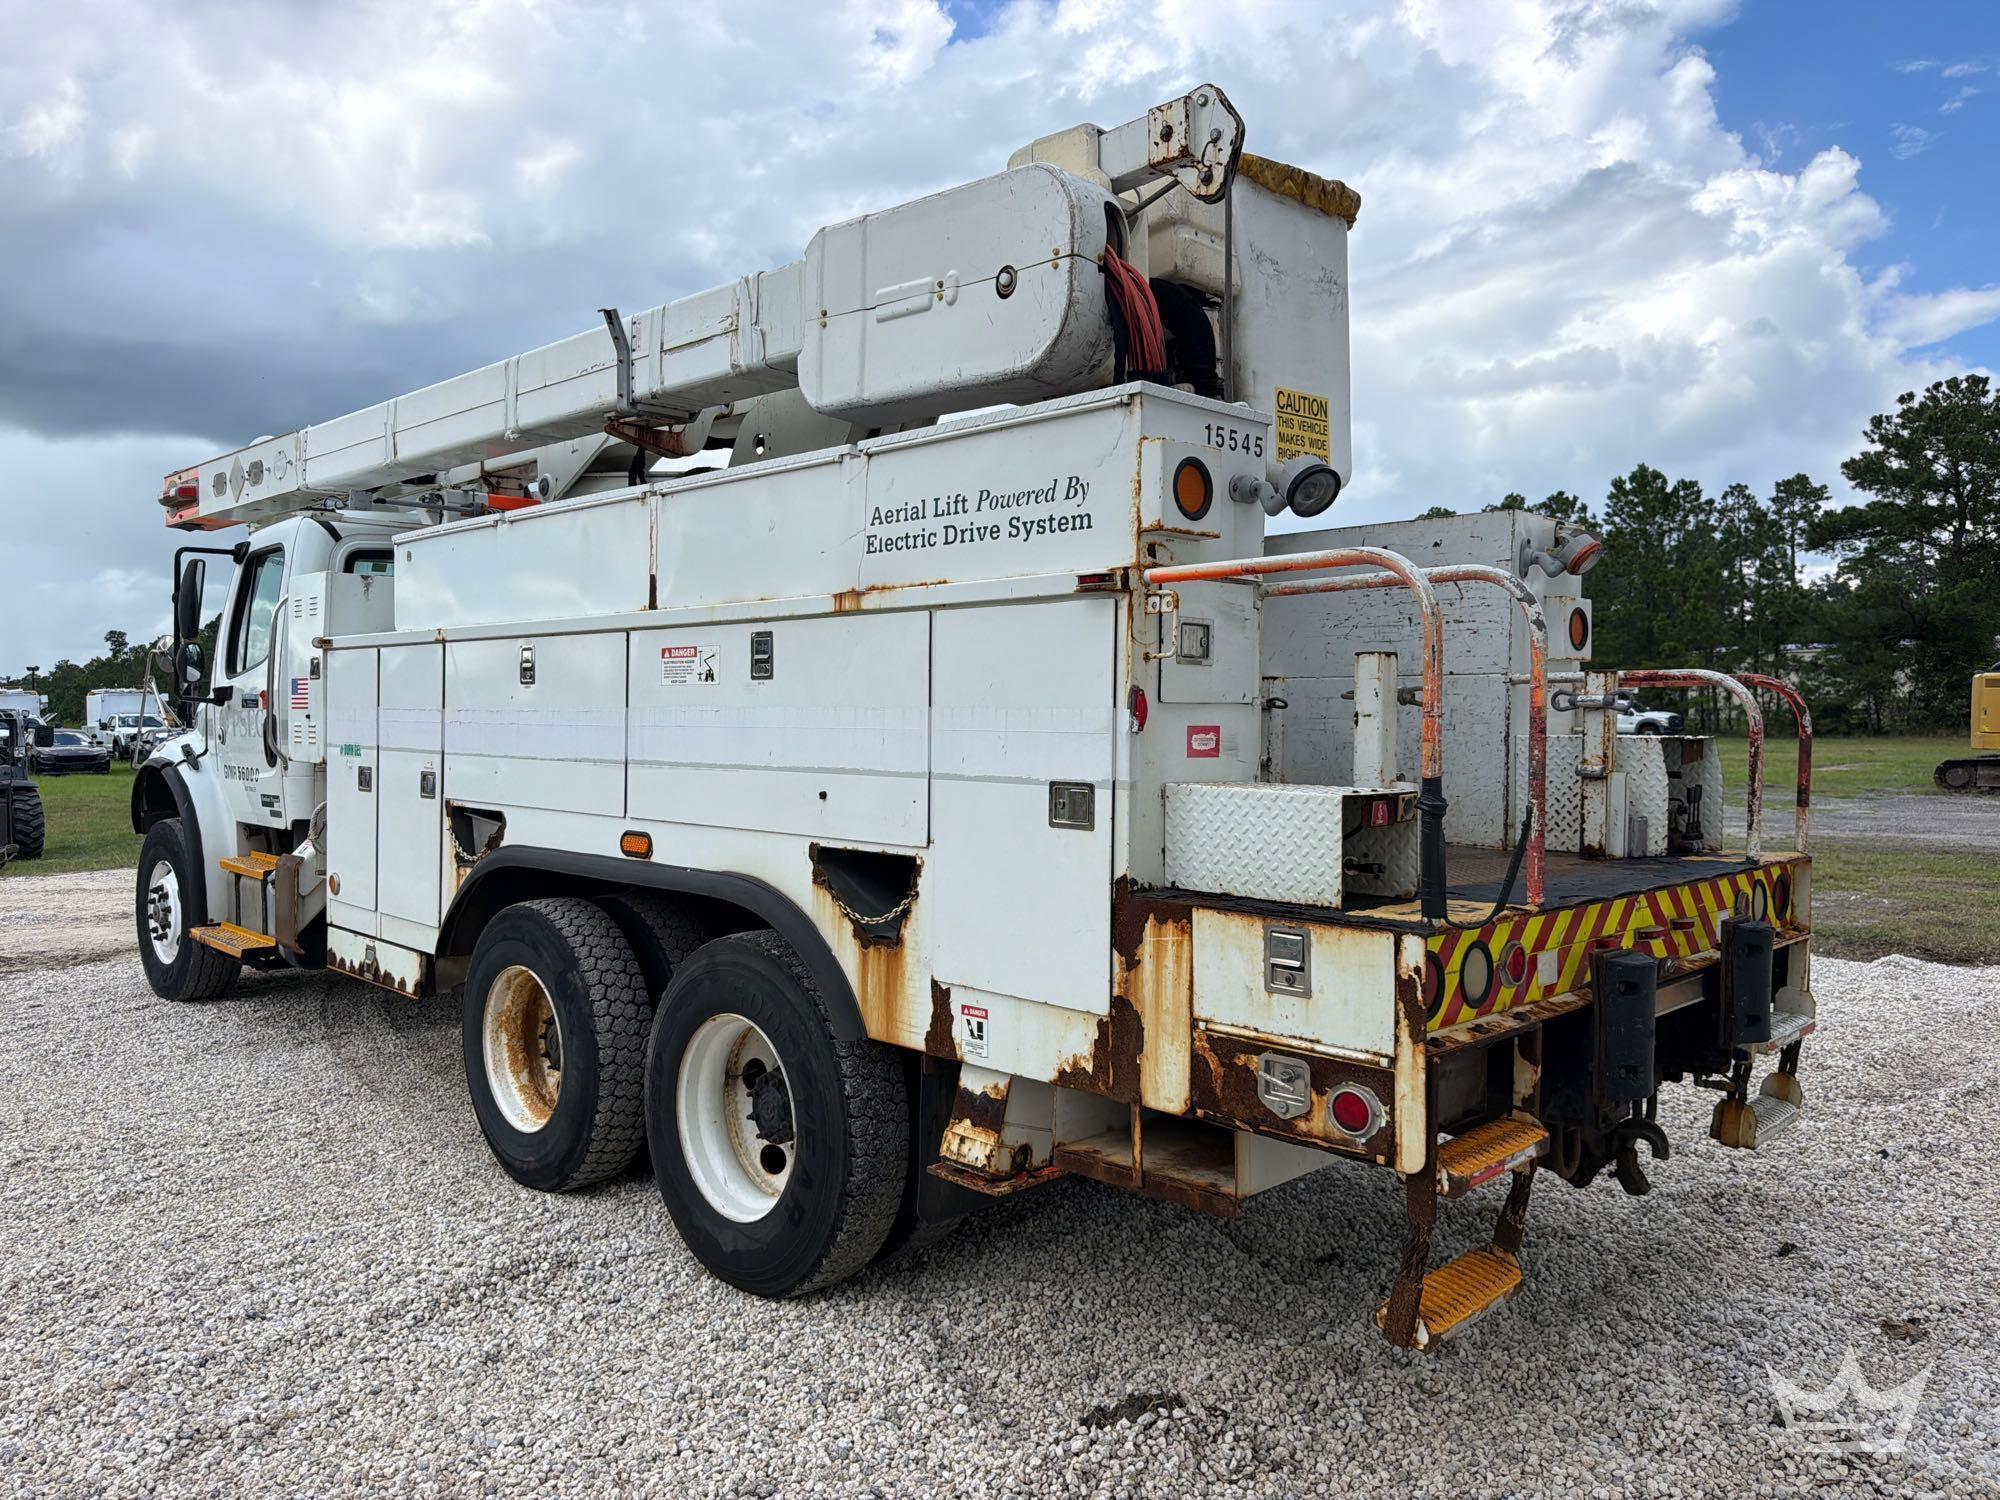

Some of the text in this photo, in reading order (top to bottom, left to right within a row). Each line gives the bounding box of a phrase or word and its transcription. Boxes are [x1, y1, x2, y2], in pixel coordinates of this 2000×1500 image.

[1276, 390, 1328, 419] CAUTION
[1277, 415, 1328, 436] THIS VEHICLE
[1204, 423, 1263, 458] 15545
[1278, 431, 1327, 452] MAKES WIDE
[1277, 447, 1301, 460] RIGHT
[869, 475, 1090, 526] Aerial Lift Powered By
[866, 512, 1093, 554] Electric Drive System
[671, 648, 695, 657] DANGER
[238, 766, 260, 783] 56000
[969, 1008, 986, 1017] DANGER
